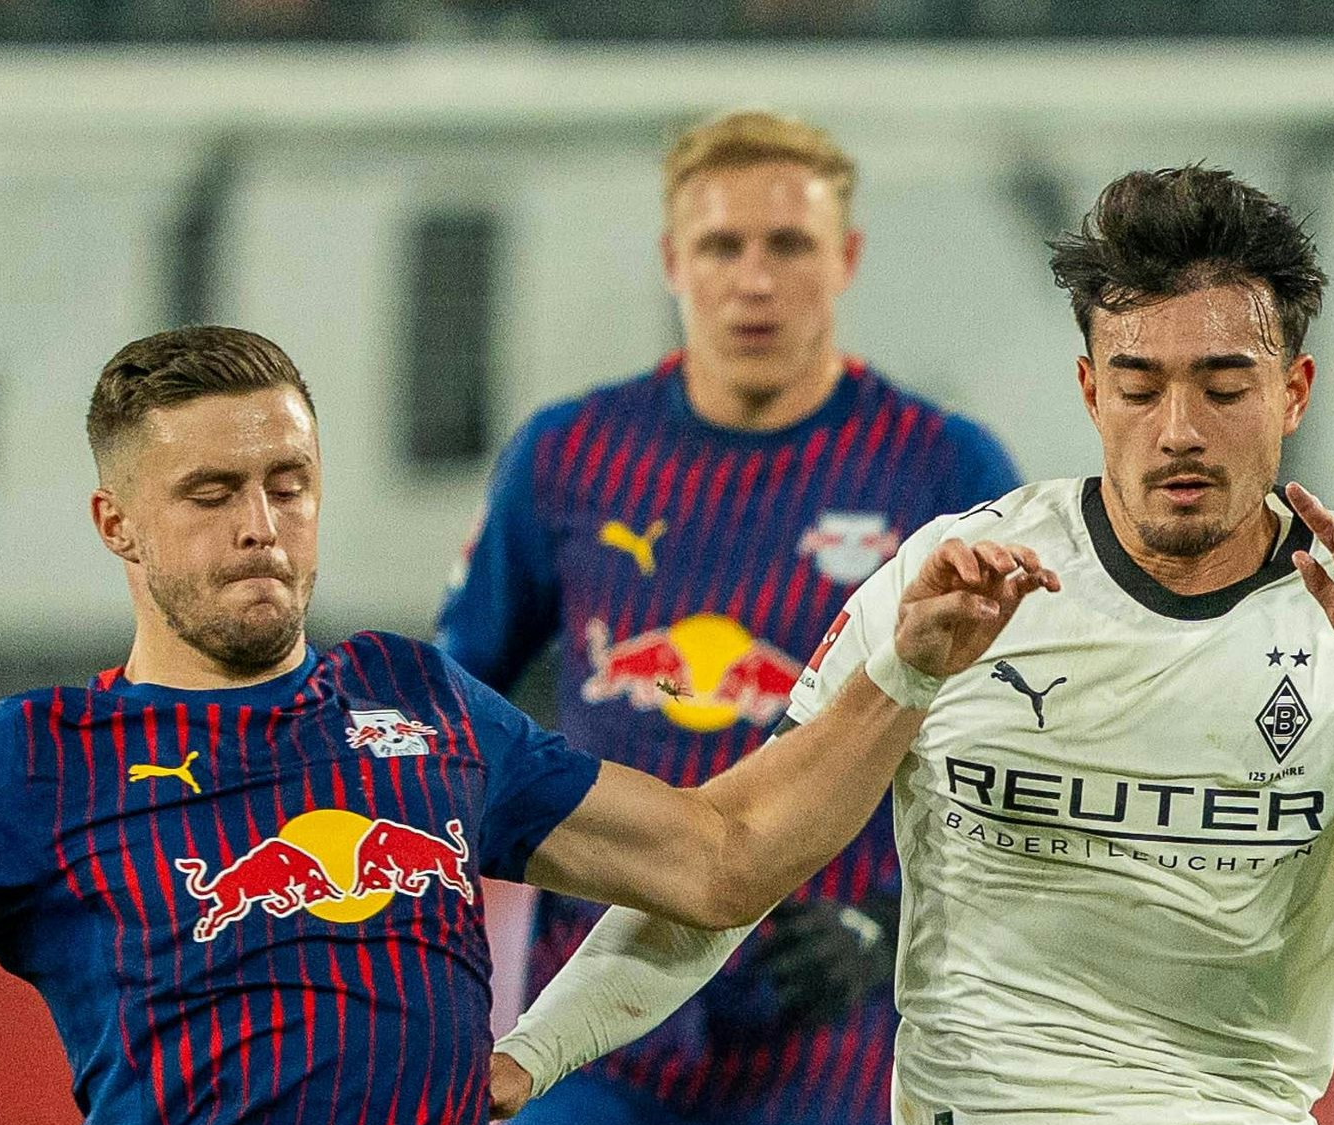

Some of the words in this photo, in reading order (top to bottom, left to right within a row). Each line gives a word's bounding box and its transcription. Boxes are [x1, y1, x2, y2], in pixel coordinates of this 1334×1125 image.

[945, 756, 1325, 832] REUTER
[1248, 771, 1267, 782] 125
[1269, 765, 1305, 782] JAHRE
